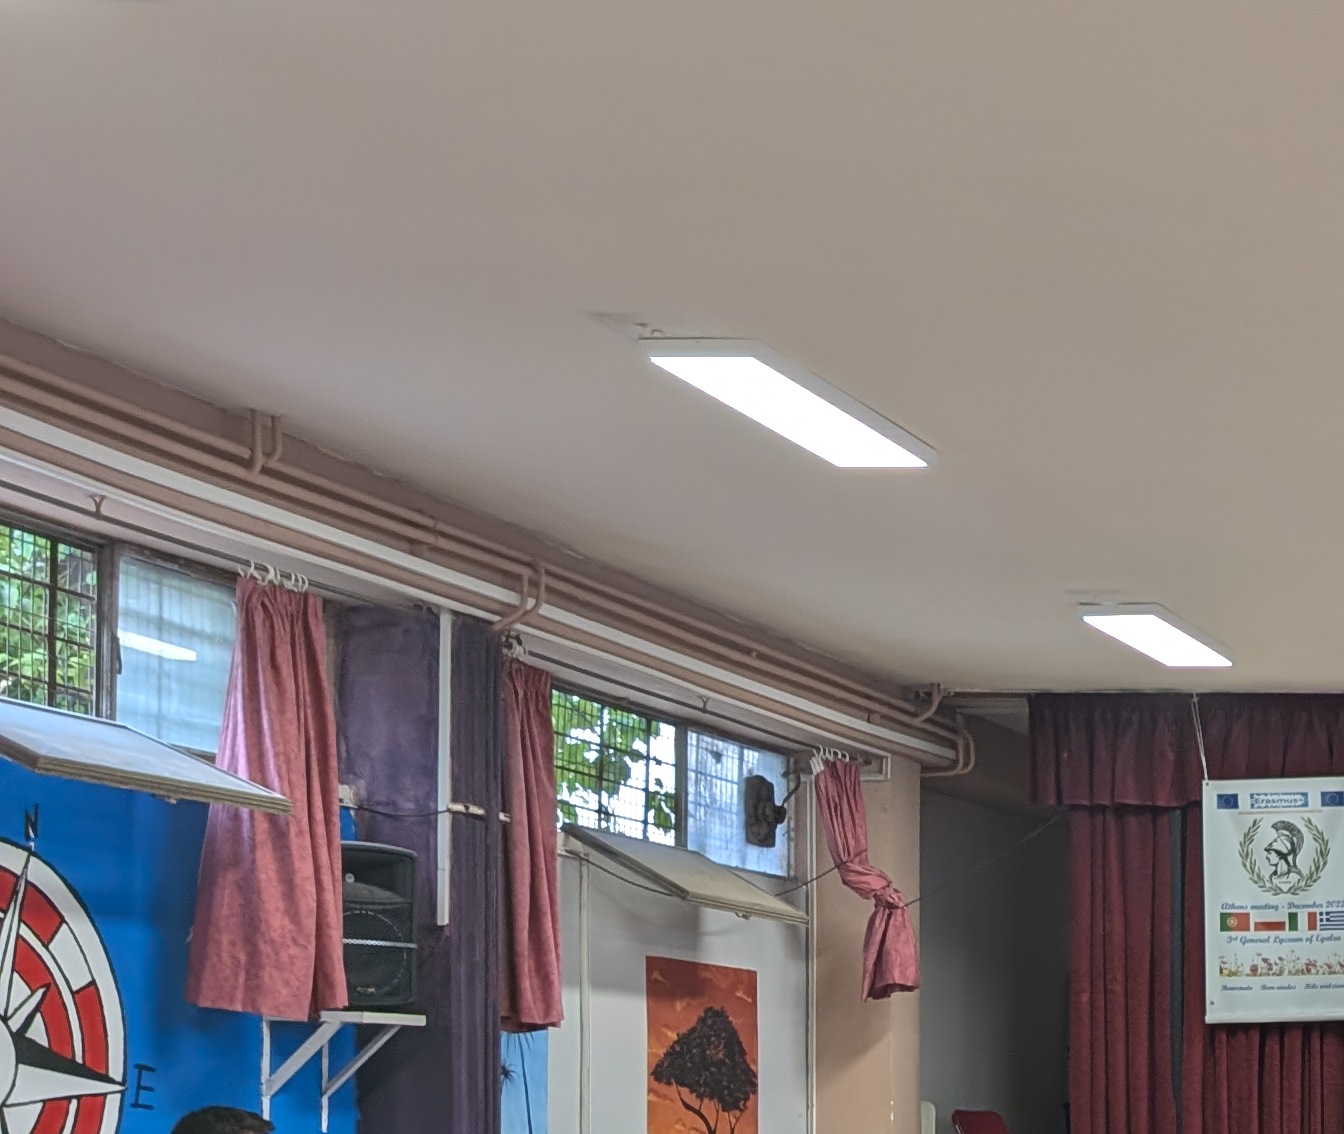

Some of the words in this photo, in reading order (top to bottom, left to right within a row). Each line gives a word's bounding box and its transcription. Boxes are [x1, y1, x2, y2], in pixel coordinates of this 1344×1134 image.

[24, 803, 39, 841] N
[1221, 902, 1248, 910] Athens
[1250, 903, 1279, 912] meeting
[1287, 901, 1323, 910] December
[1240, 935, 1271, 945] General
[1305, 934, 1314, 944] of
[130, 1063, 156, 1110] E
